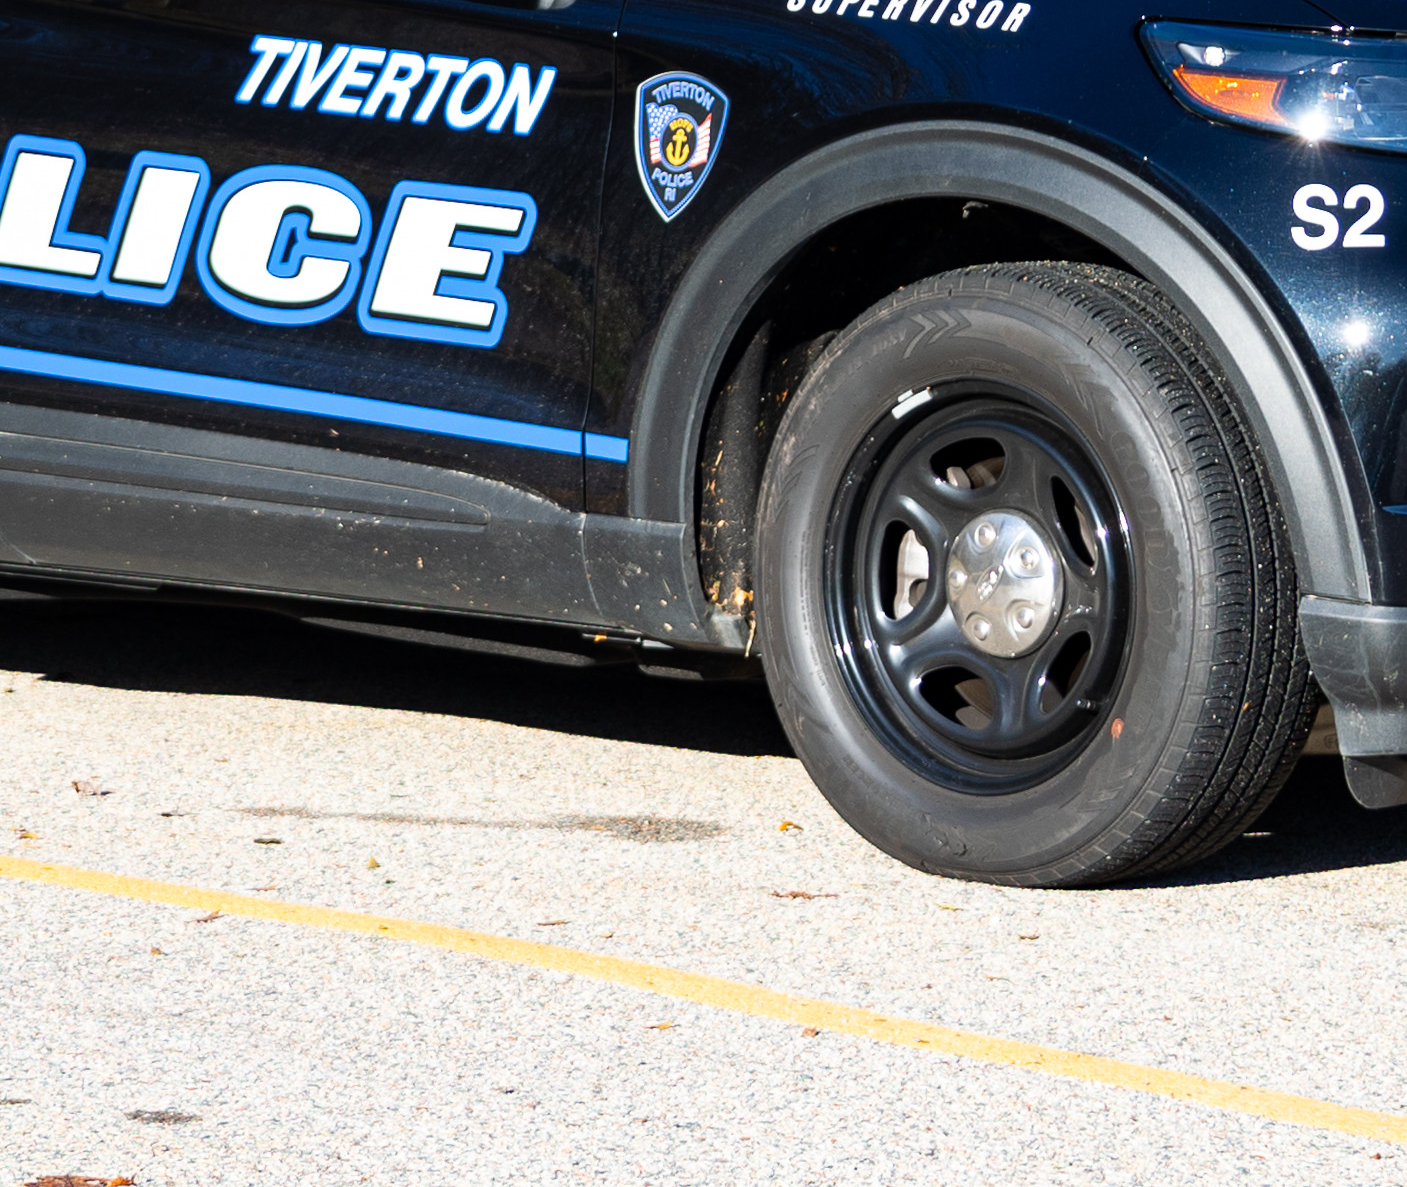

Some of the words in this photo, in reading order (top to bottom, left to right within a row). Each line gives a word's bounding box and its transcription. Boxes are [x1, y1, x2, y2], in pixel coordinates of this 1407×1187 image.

[236, 34, 557, 137] TIVERTON
[651, 81, 715, 111] TIVERTON
[651, 167, 694, 188] POLICE
[664, 187, 677, 202] RI
[1289, 182, 1388, 252] S2
